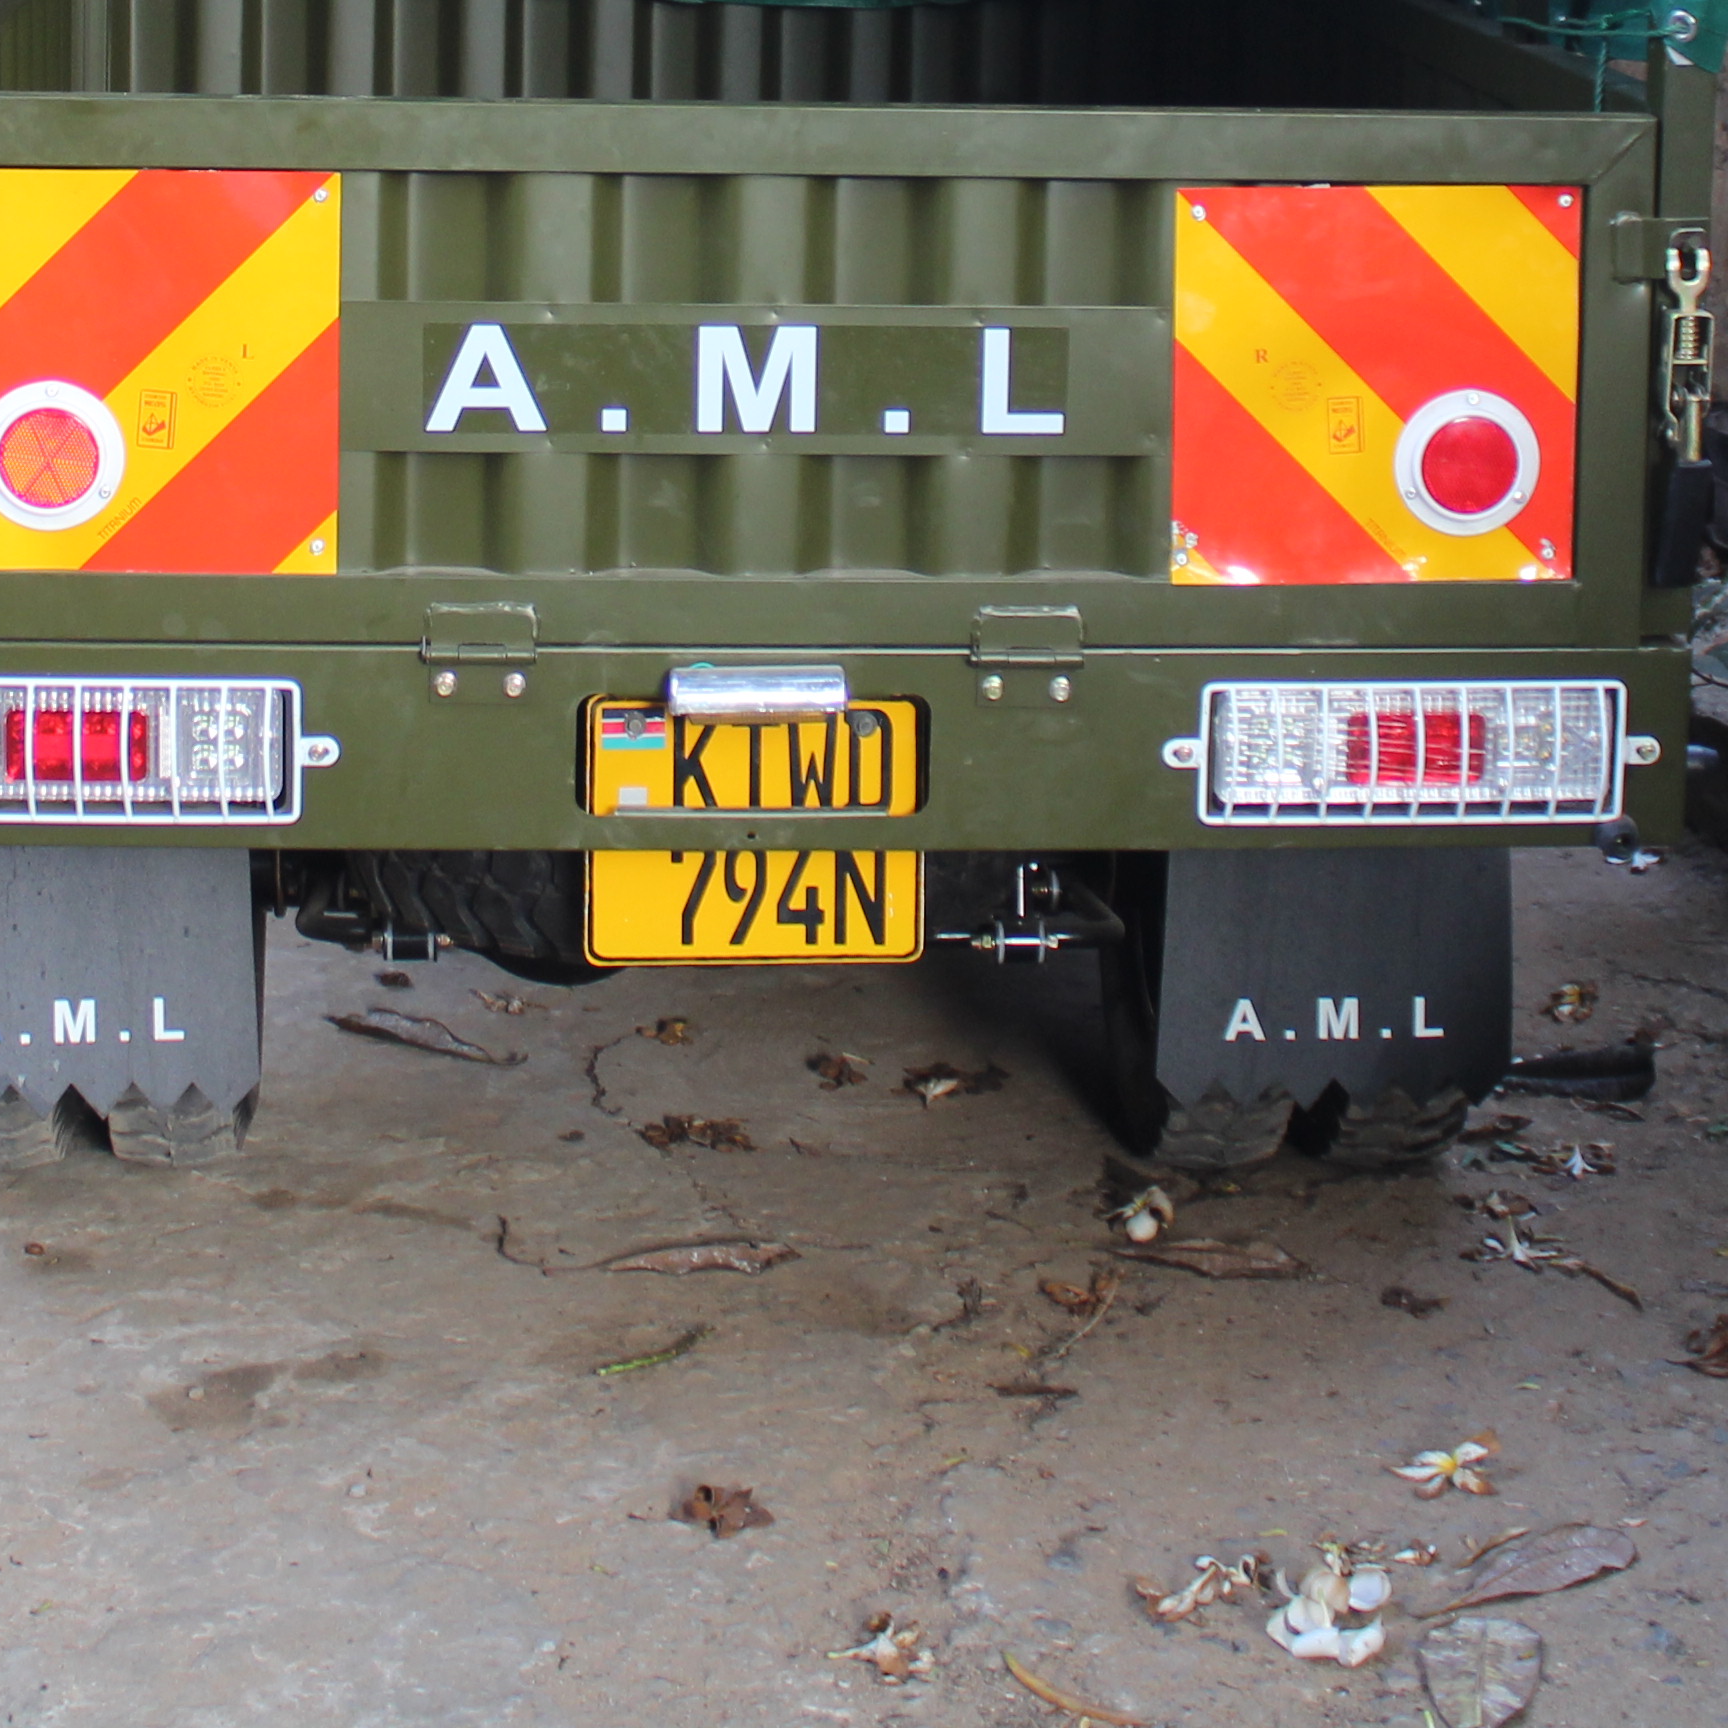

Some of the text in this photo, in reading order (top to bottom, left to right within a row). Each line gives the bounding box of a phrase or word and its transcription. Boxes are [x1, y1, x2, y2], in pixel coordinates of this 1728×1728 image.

[242, 343, 255, 359] L
[1255, 349, 1269, 363] R
[97, 496, 142, 540] TITANIUM
[672, 708, 894, 809] KTWD
[671, 850, 886, 946] 794N
